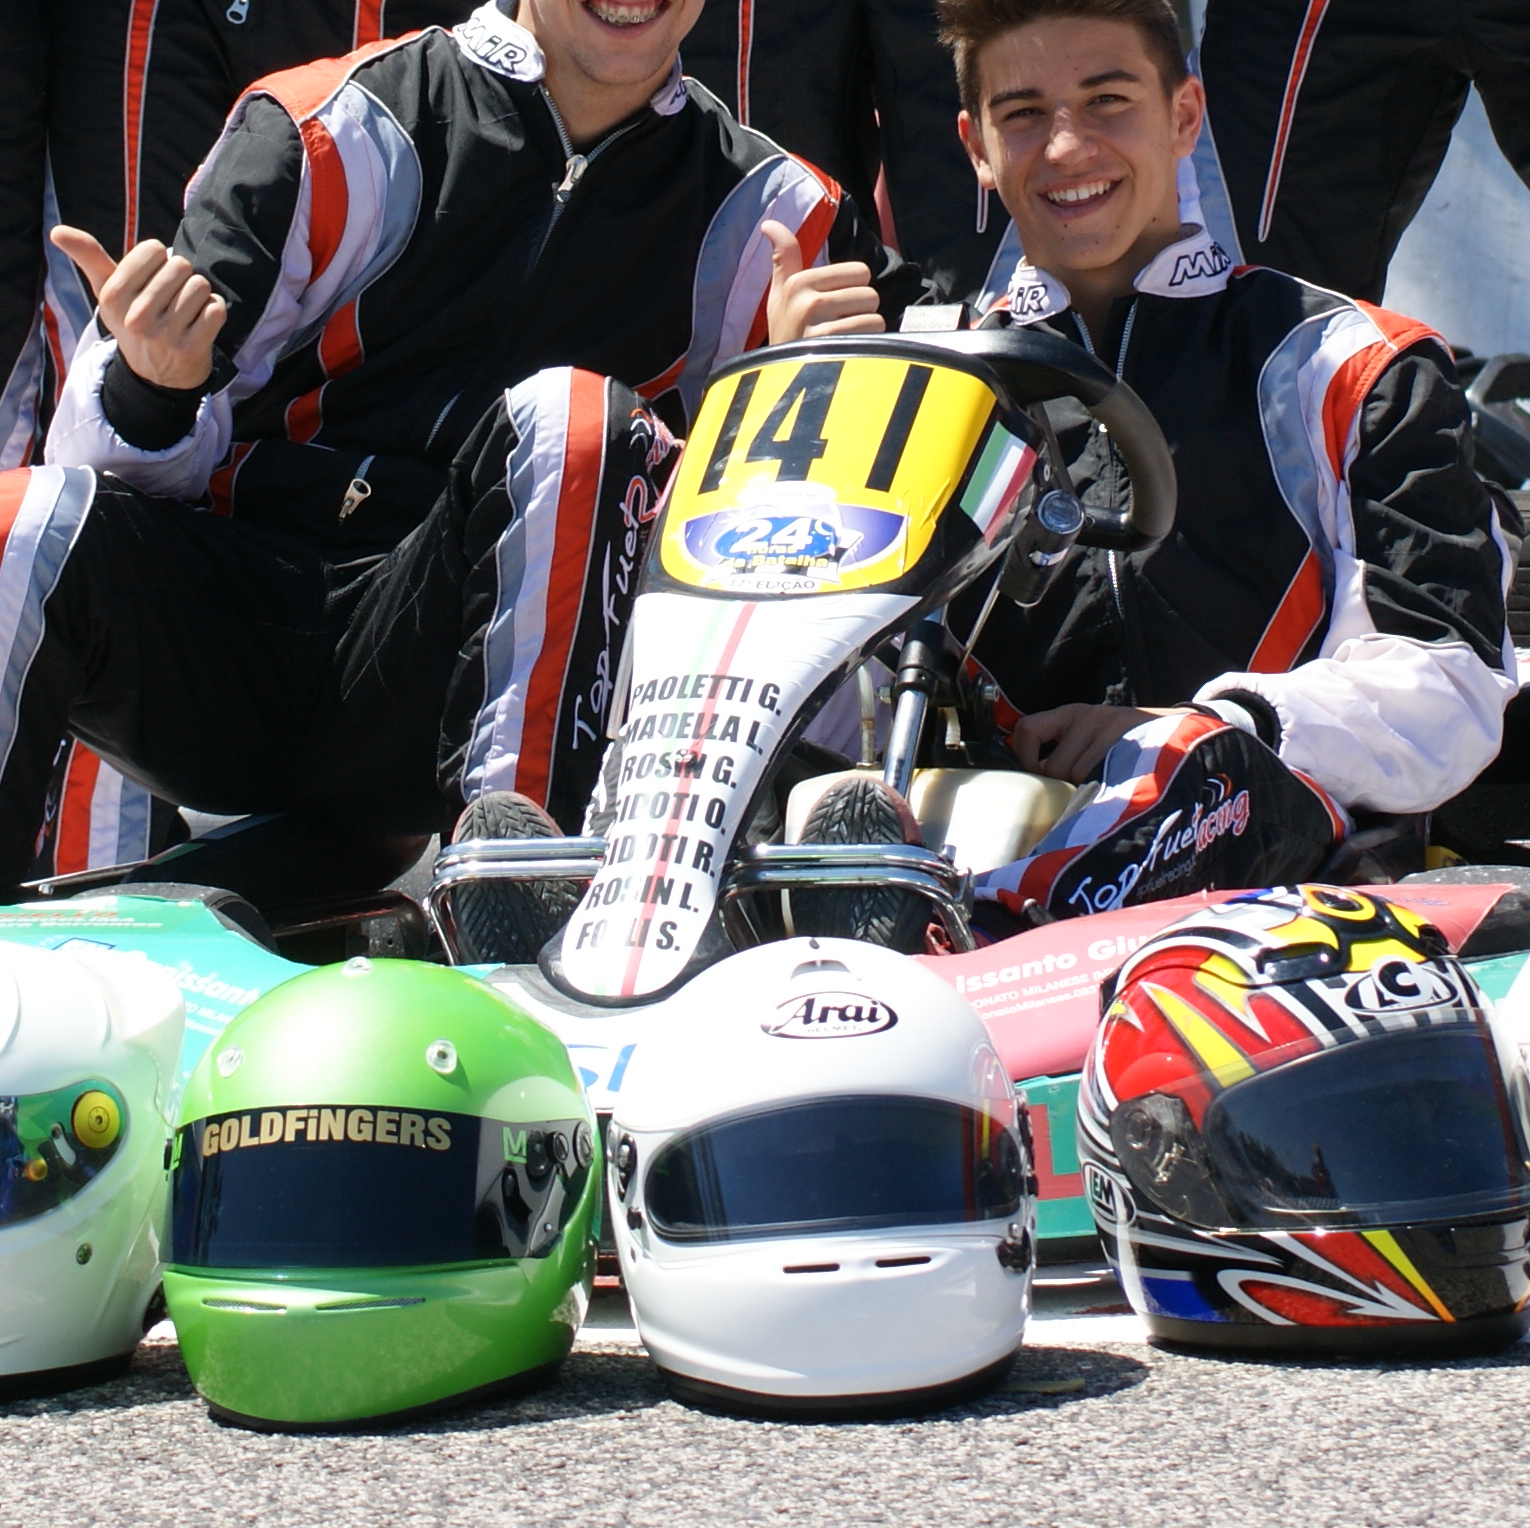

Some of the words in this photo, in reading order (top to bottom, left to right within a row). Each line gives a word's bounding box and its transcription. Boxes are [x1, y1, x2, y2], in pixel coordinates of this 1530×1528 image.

[728, 516, 814, 555] 24
[750, 553, 830, 569] Batalha
[630, 674, 755, 711] PAOLETTI
[758, 681, 782, 717] G.
[745, 720, 765, 757] L.
[711, 754, 738, 790] G.
[703, 796, 727, 836] O.
[691, 839, 716, 879] R.
[678, 881, 700, 914] L.
[575, 917, 653, 952] FOLI
[655, 920, 681, 952] S.
[956, 952, 1078, 995] issanto
[1021, 972, 1090, 998] MILANESE
[771, 996, 884, 1032] Arai
